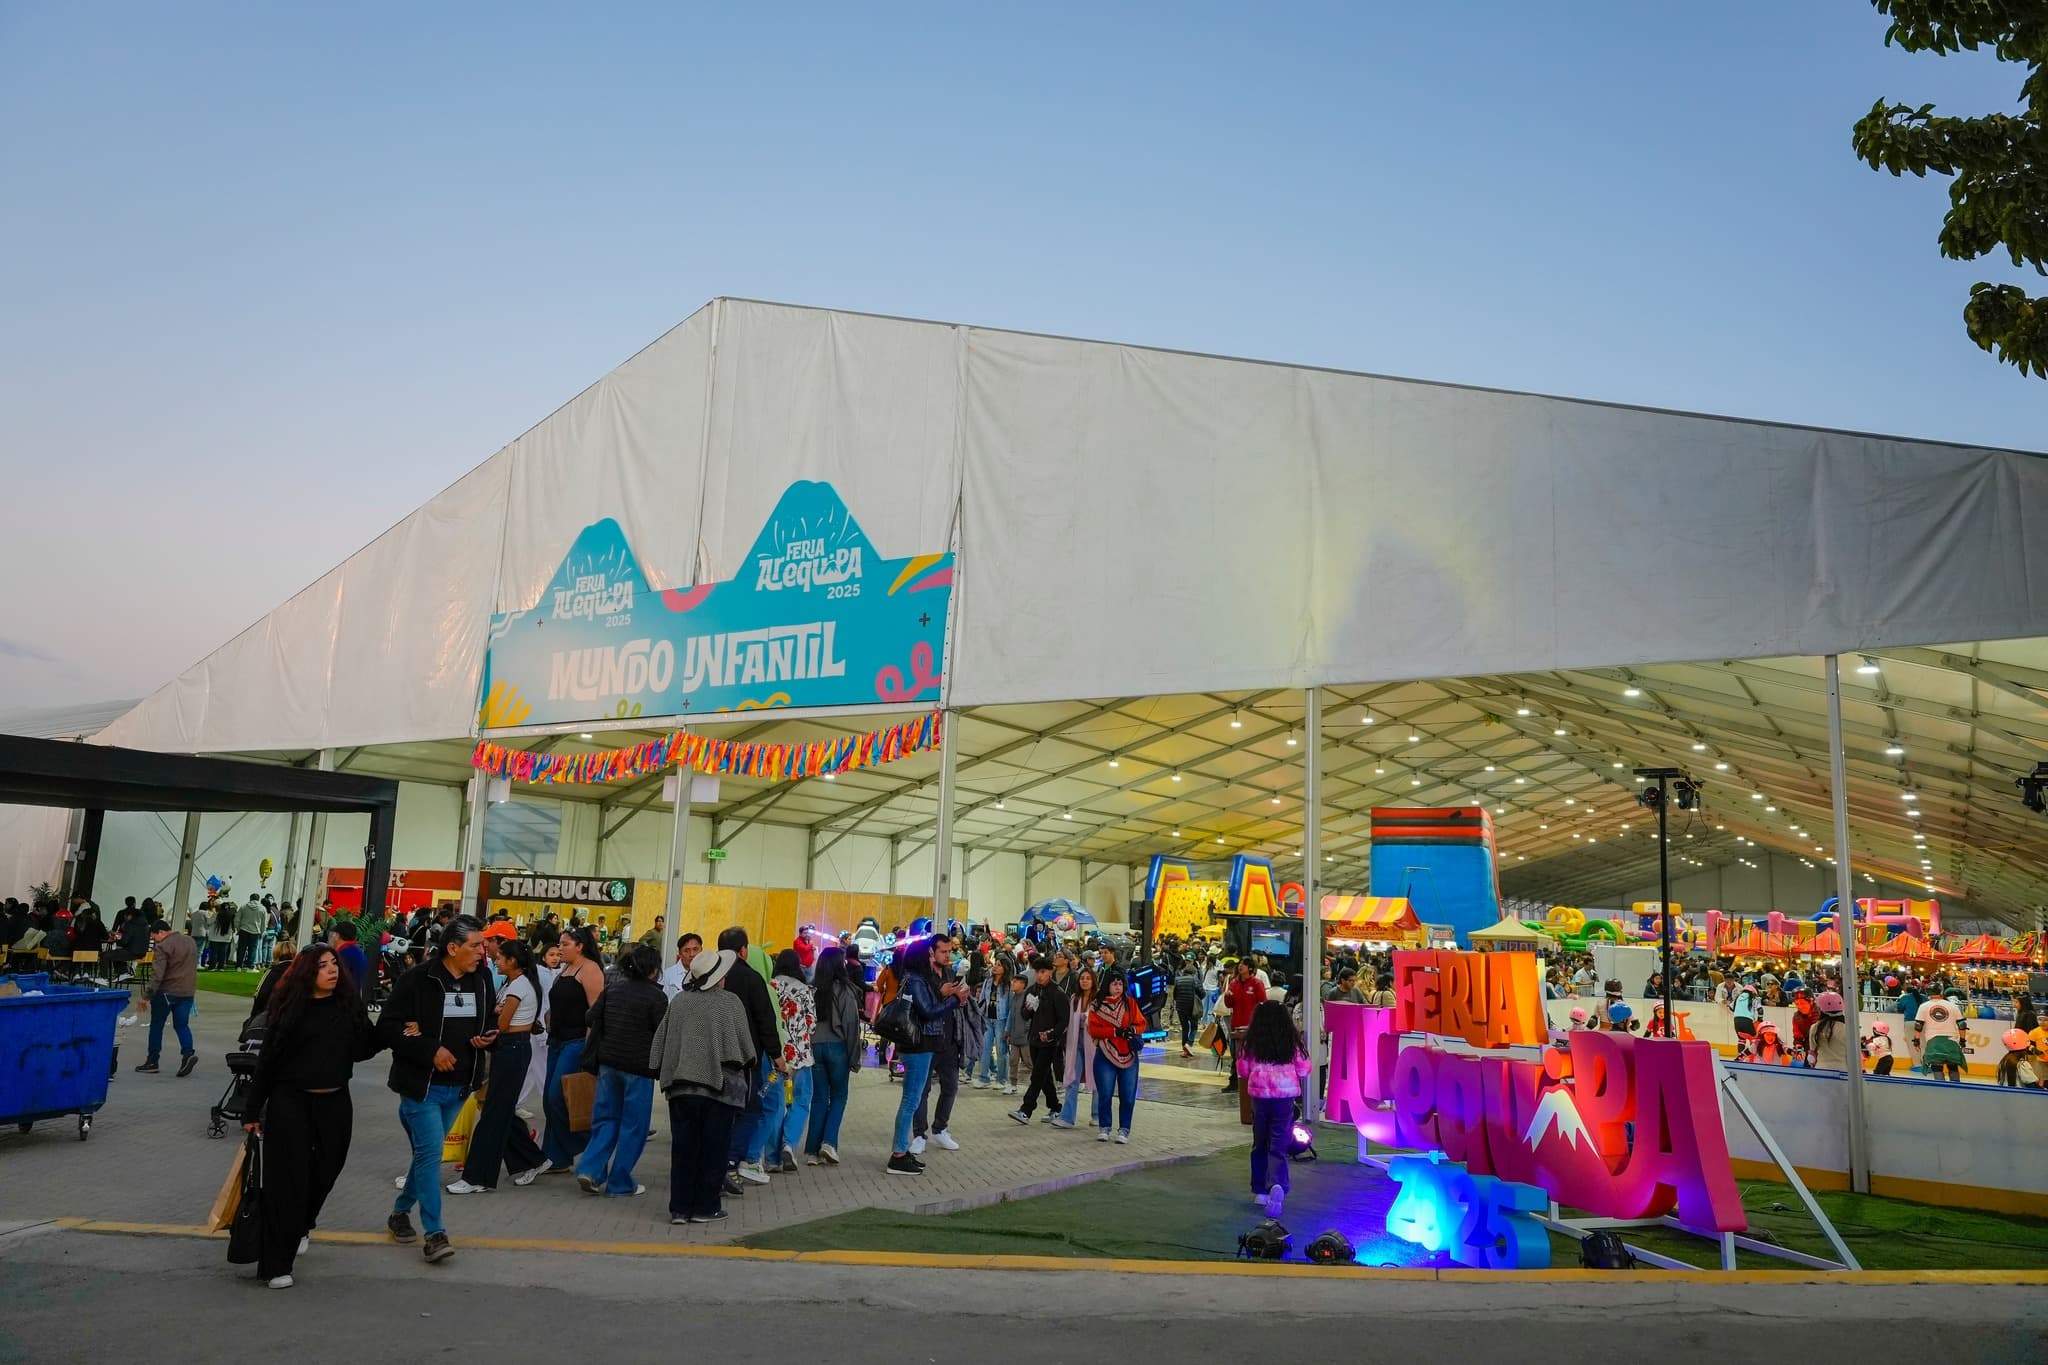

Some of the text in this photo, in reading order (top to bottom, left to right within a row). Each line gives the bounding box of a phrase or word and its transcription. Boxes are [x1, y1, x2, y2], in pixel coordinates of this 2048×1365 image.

[786, 538, 825, 560] FERIA
[575, 574, 606, 593] FERIA
[827, 583, 861, 600] 2025
[605, 614, 632, 628] 2025
[548, 621, 846, 700] MUNDO INFANTIL
[387, 870, 409, 887] FC
[1391, 950, 1549, 1048] FERIA
[1386, 1156, 1552, 1269] 225
